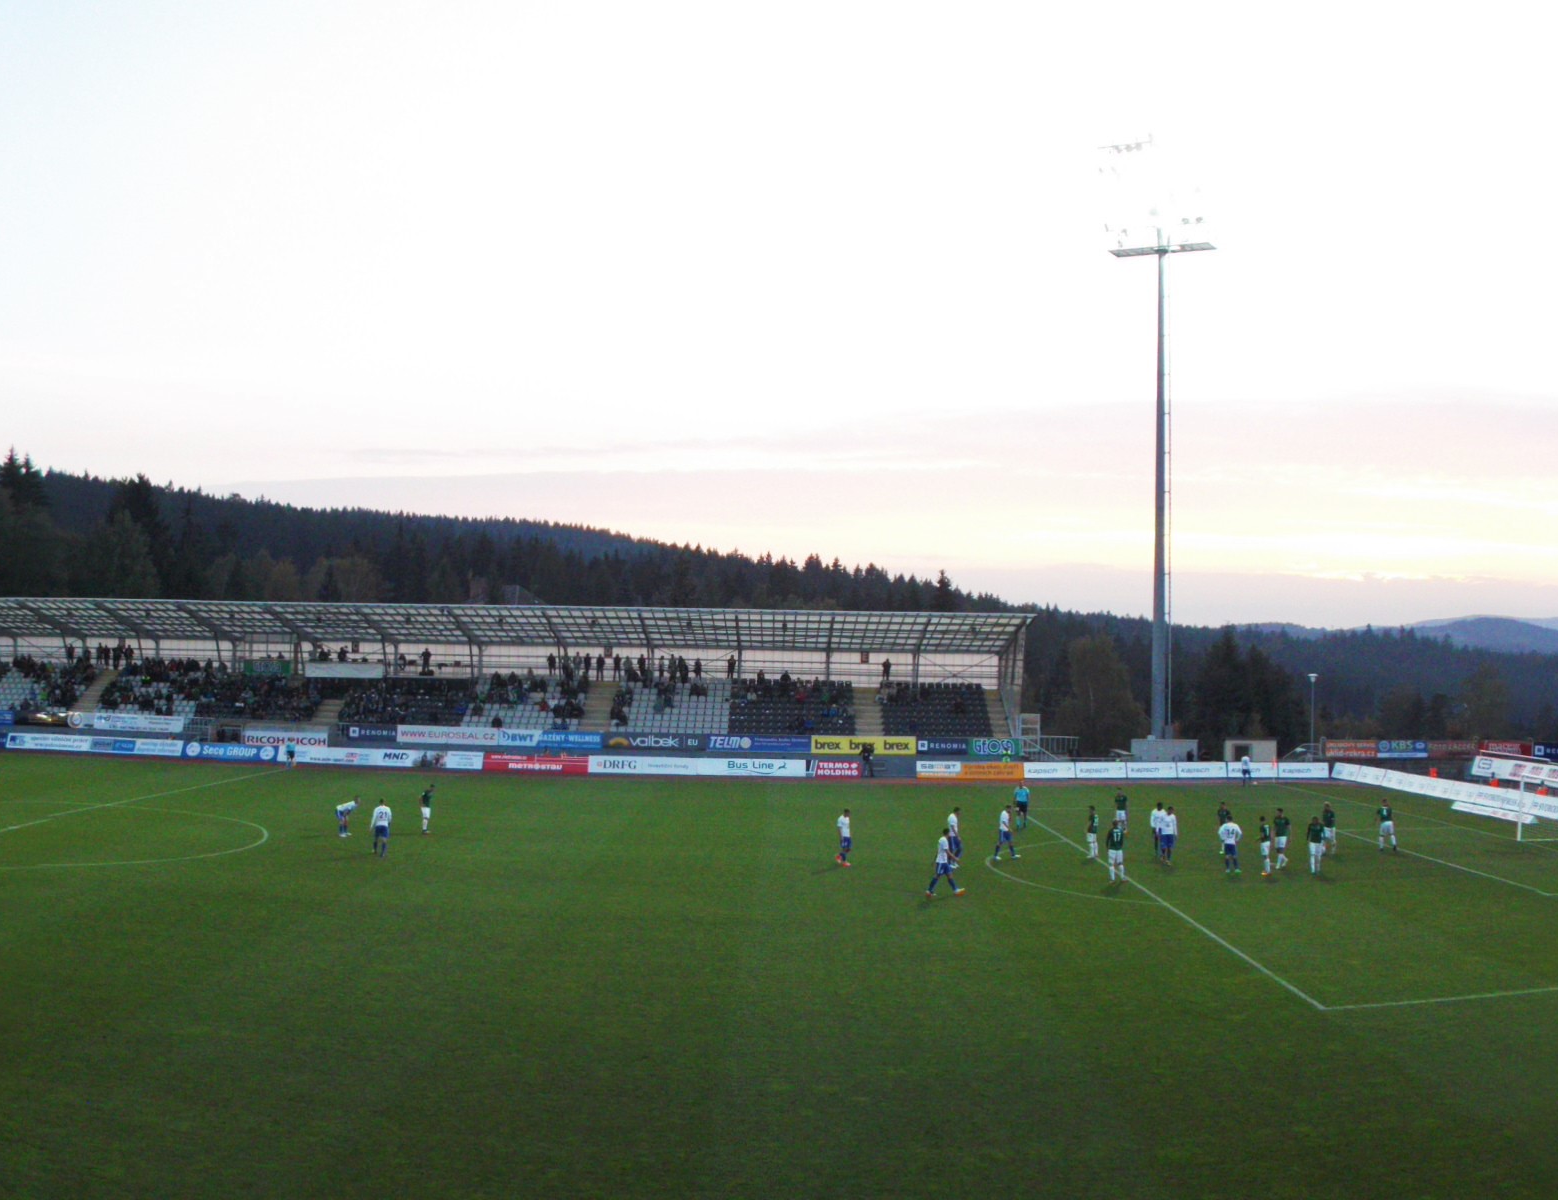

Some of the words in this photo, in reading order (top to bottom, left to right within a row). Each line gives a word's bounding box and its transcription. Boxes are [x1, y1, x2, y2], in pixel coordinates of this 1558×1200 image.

[247, 735, 285, 744] RICOH
[511, 734, 534, 742] BWT
[629, 735, 679, 748] valbek
[687, 738, 699, 746] EU
[815, 740, 841, 750] brex
[883, 740, 909, 750] brex
[1391, 740, 1413, 750] KBS
[203, 746, 224, 756] Seco
[227, 747, 257, 757] GROUP
[383, 752, 409, 760] MND
[603, 760, 637, 770] DRFG
[728, 760, 748, 769] Bus
[753, 761, 774, 770] Line
[1131, 766, 1160, 774] kapsch
